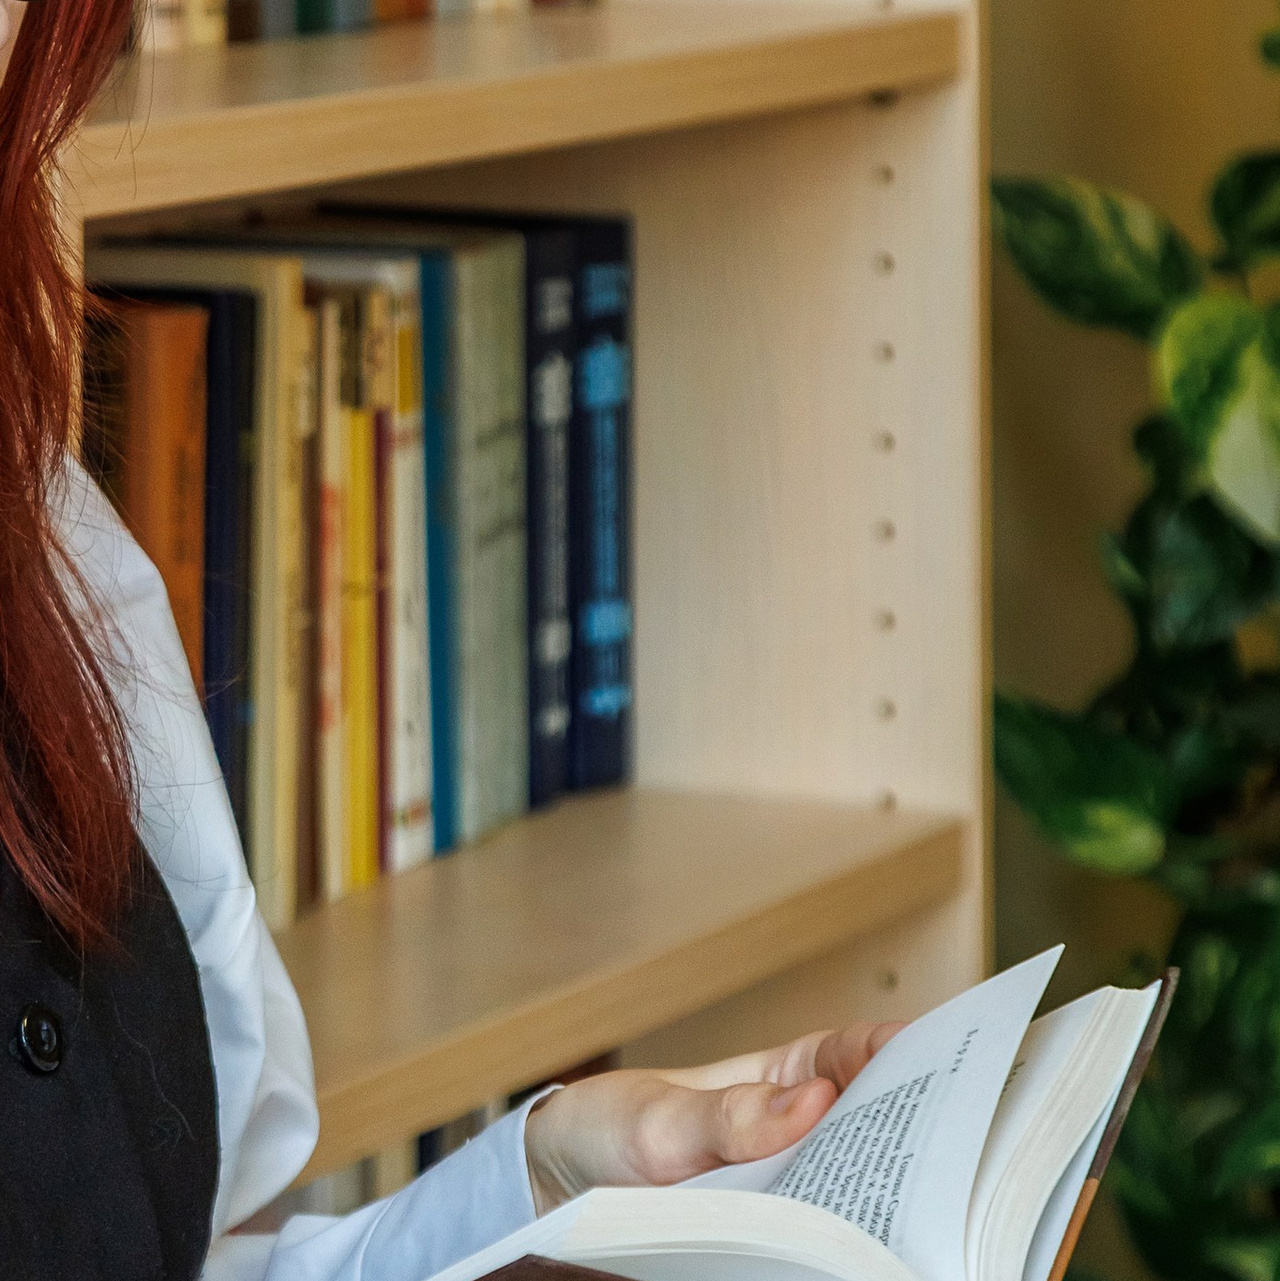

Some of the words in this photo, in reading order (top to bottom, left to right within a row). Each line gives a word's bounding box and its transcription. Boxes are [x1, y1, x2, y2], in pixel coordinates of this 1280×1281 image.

[811, 1157, 839, 1206] британце
[882, 1154, 898, 1180] вера
[891, 1153, 914, 1197] Головы
[857, 1195, 872, 1224] если
[867, 1193, 885, 1239] свобод
